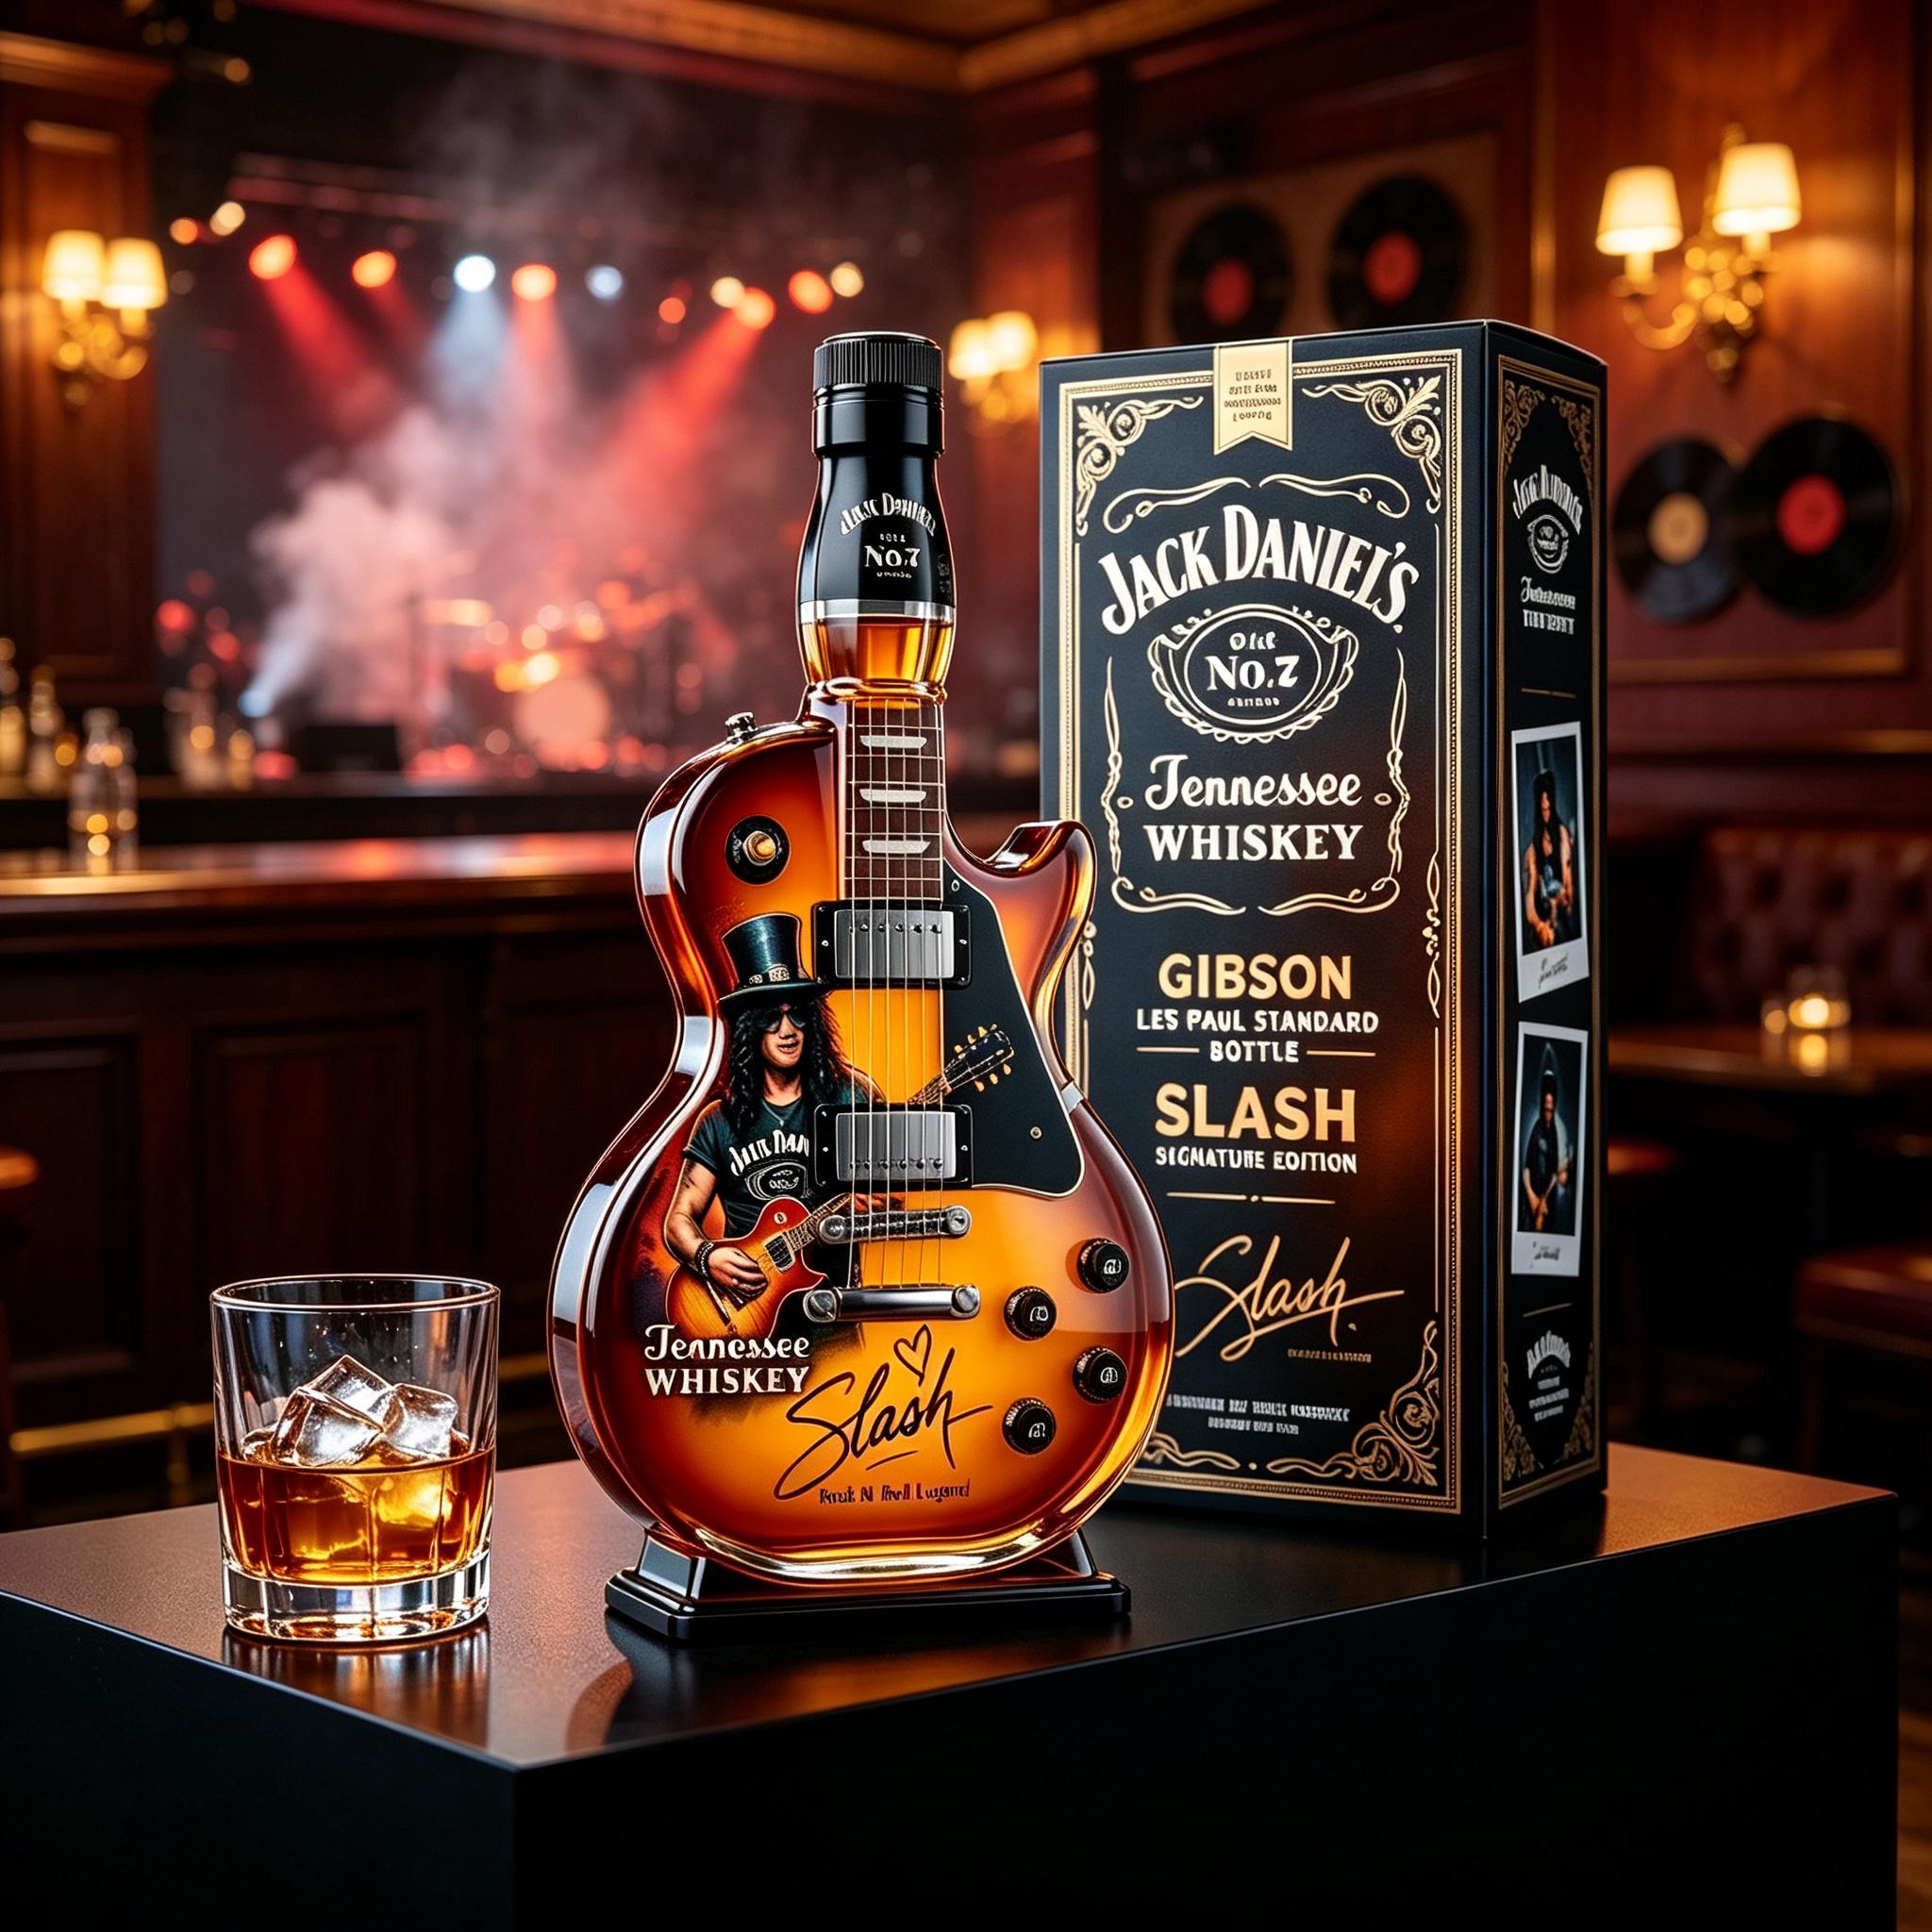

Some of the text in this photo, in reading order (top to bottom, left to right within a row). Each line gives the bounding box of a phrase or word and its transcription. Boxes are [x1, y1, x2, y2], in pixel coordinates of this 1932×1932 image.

[1098, 504, 1420, 636] JACK DANIEL'S
[1144, 754, 1362, 810] Tennessee
[1142, 824, 1364, 861] WHISKEY
[1158, 952, 1352, 1001] GIBSON
[1136, 1008, 1380, 1034] LES PAUL STANDARD
[1209, 1040, 1300, 1064] BOTTLE
[1154, 1082, 1357, 1143] SLASH
[643, 1323, 811, 1361] Tennessee
[643, 1365, 811, 1396] WHISKEY
[773, 1345, 995, 1501] Slash
